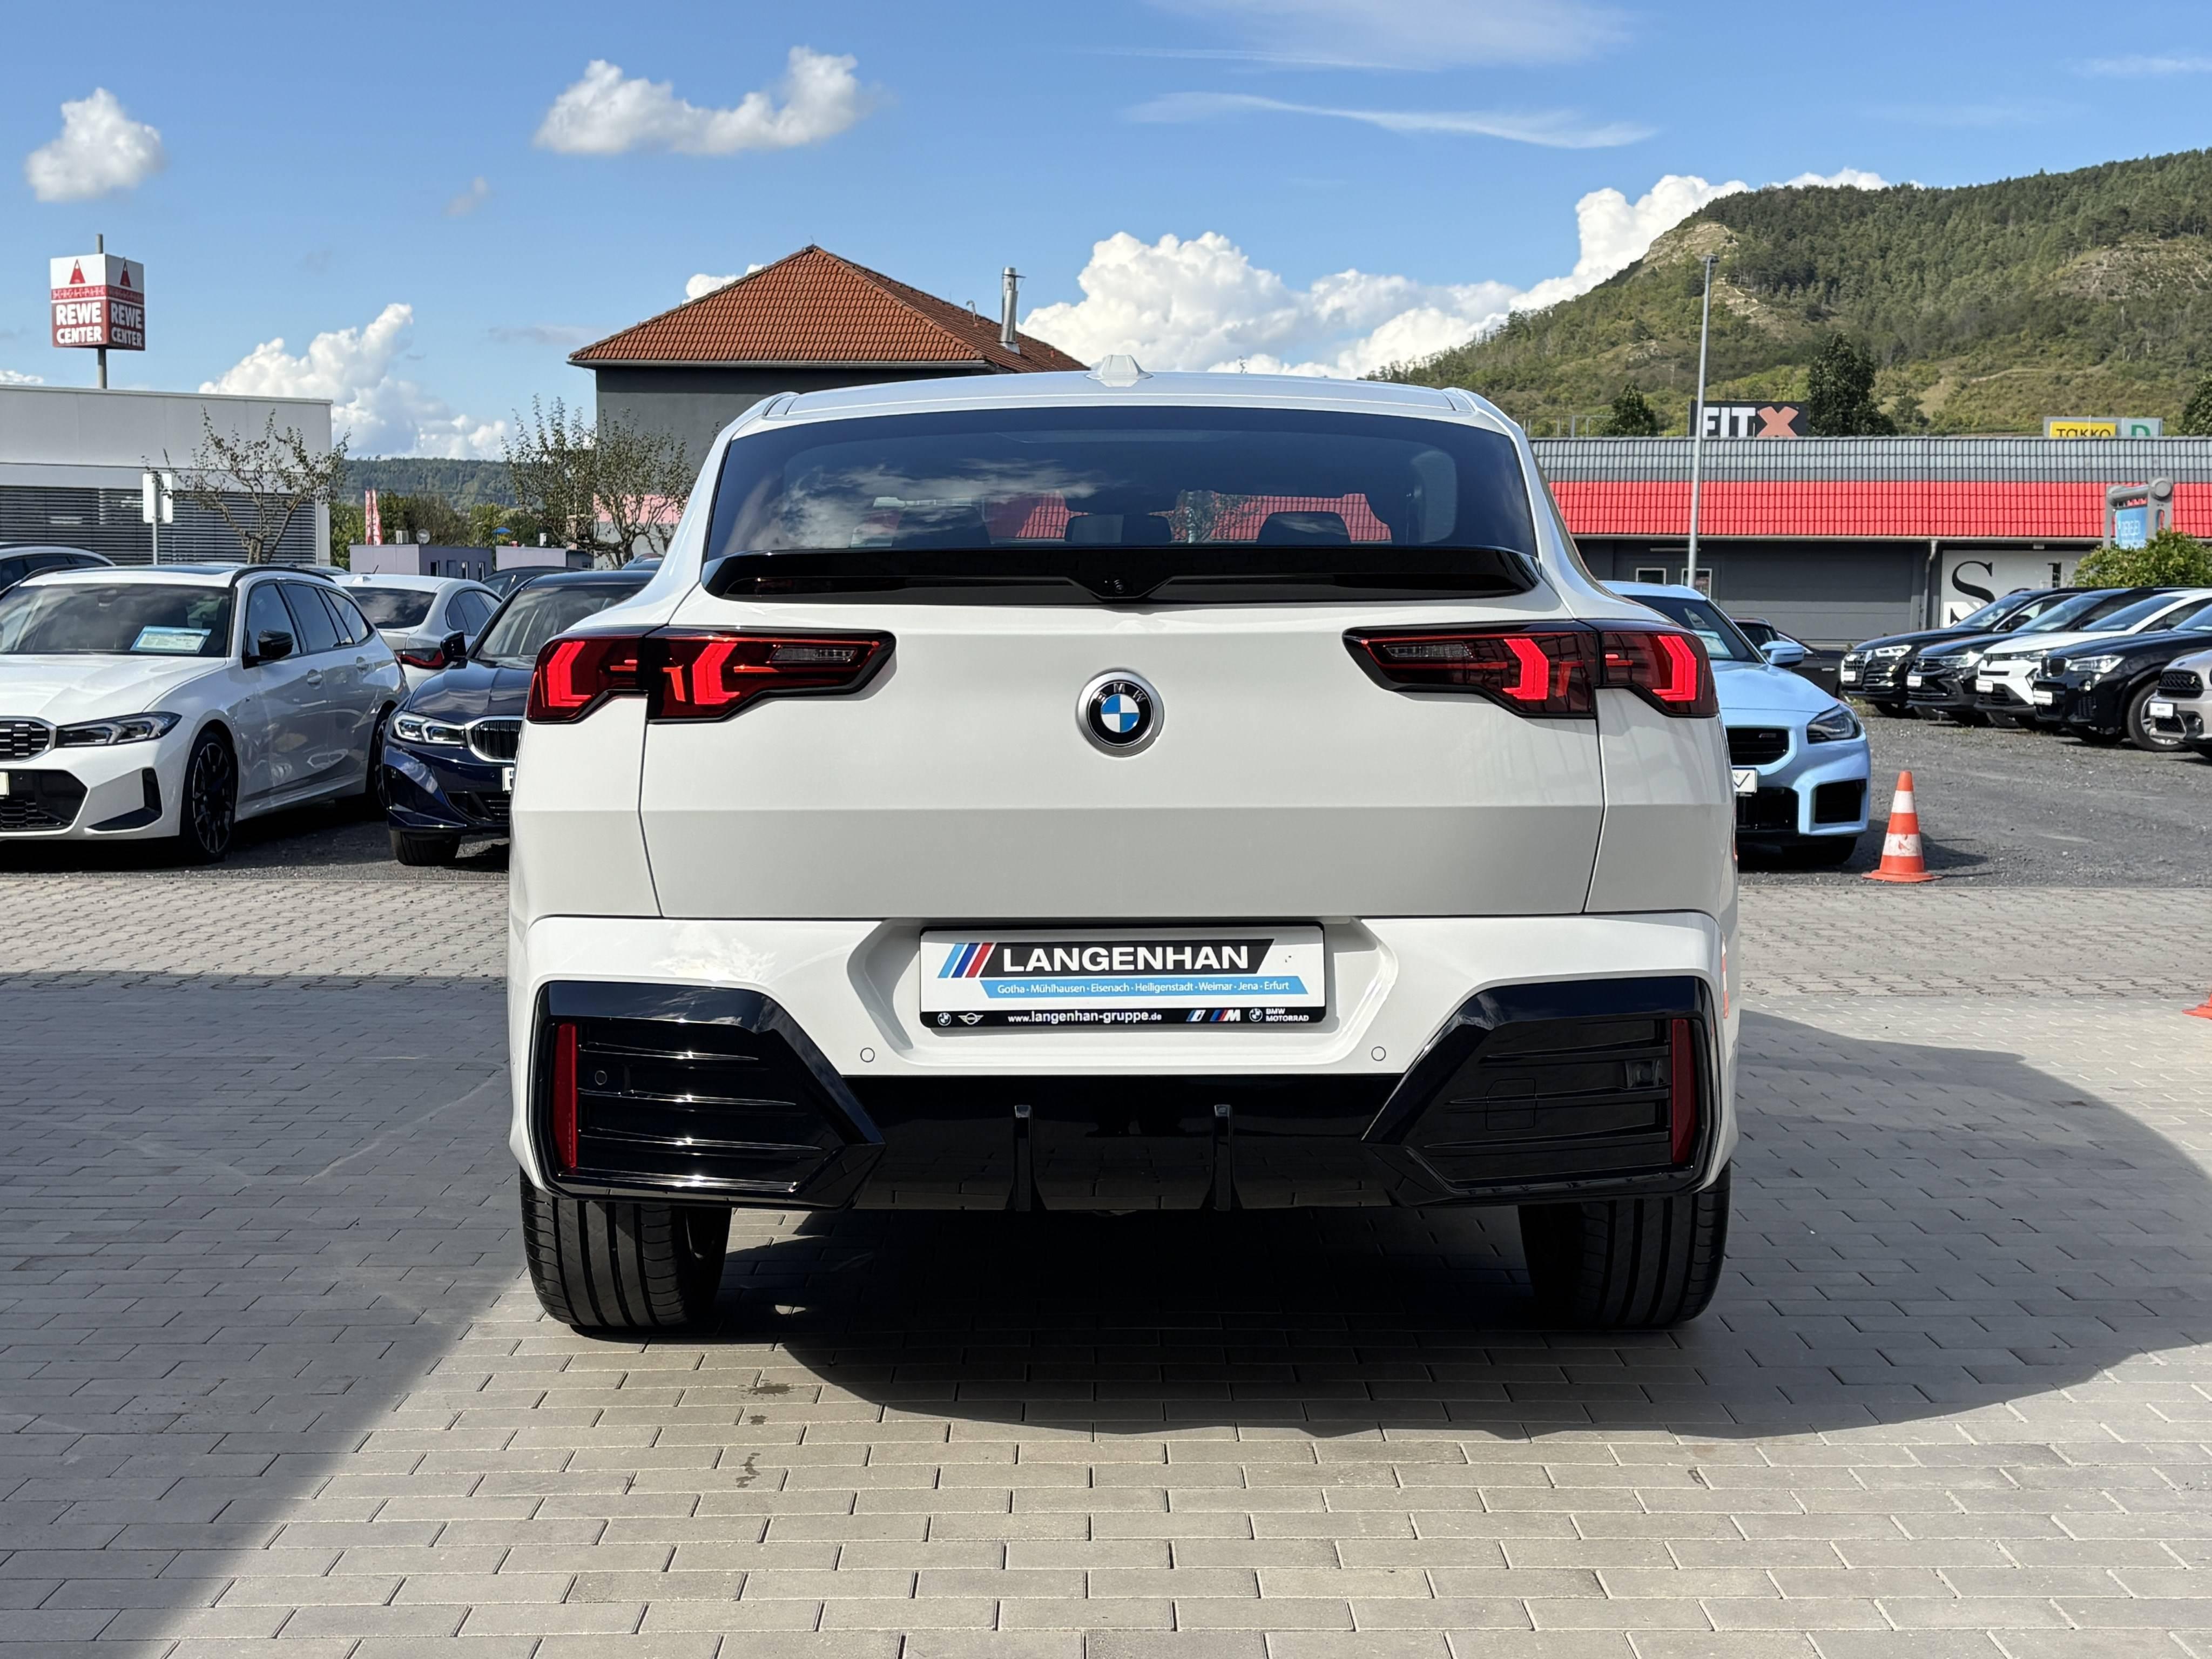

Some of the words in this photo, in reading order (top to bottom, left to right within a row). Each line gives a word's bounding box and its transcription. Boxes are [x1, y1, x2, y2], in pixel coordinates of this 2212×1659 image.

[56, 302, 102, 326] REWE
[111, 303, 143, 329] REWE
[57, 326, 102, 344] CENTER
[111, 327, 142, 347] CENTER
[1094, 683, 1147, 702] BMW
[1003, 946, 1248, 972] LANGENHAN
[997, 984, 1025, 994] Gotha
[1030, 983, 1085, 993] Mühlhausen
[1091, 982, 1130, 993] Eisenach
[1135, 982, 1193, 994] Heiligenstadt
[1198, 981, 1233, 991] Weimar
[1238, 982, 1259, 990] Jena
[1264, 980, 1290, 990] Erfurt
[1008, 1010, 1162, 1024] www.langenhan-gruppe.de
